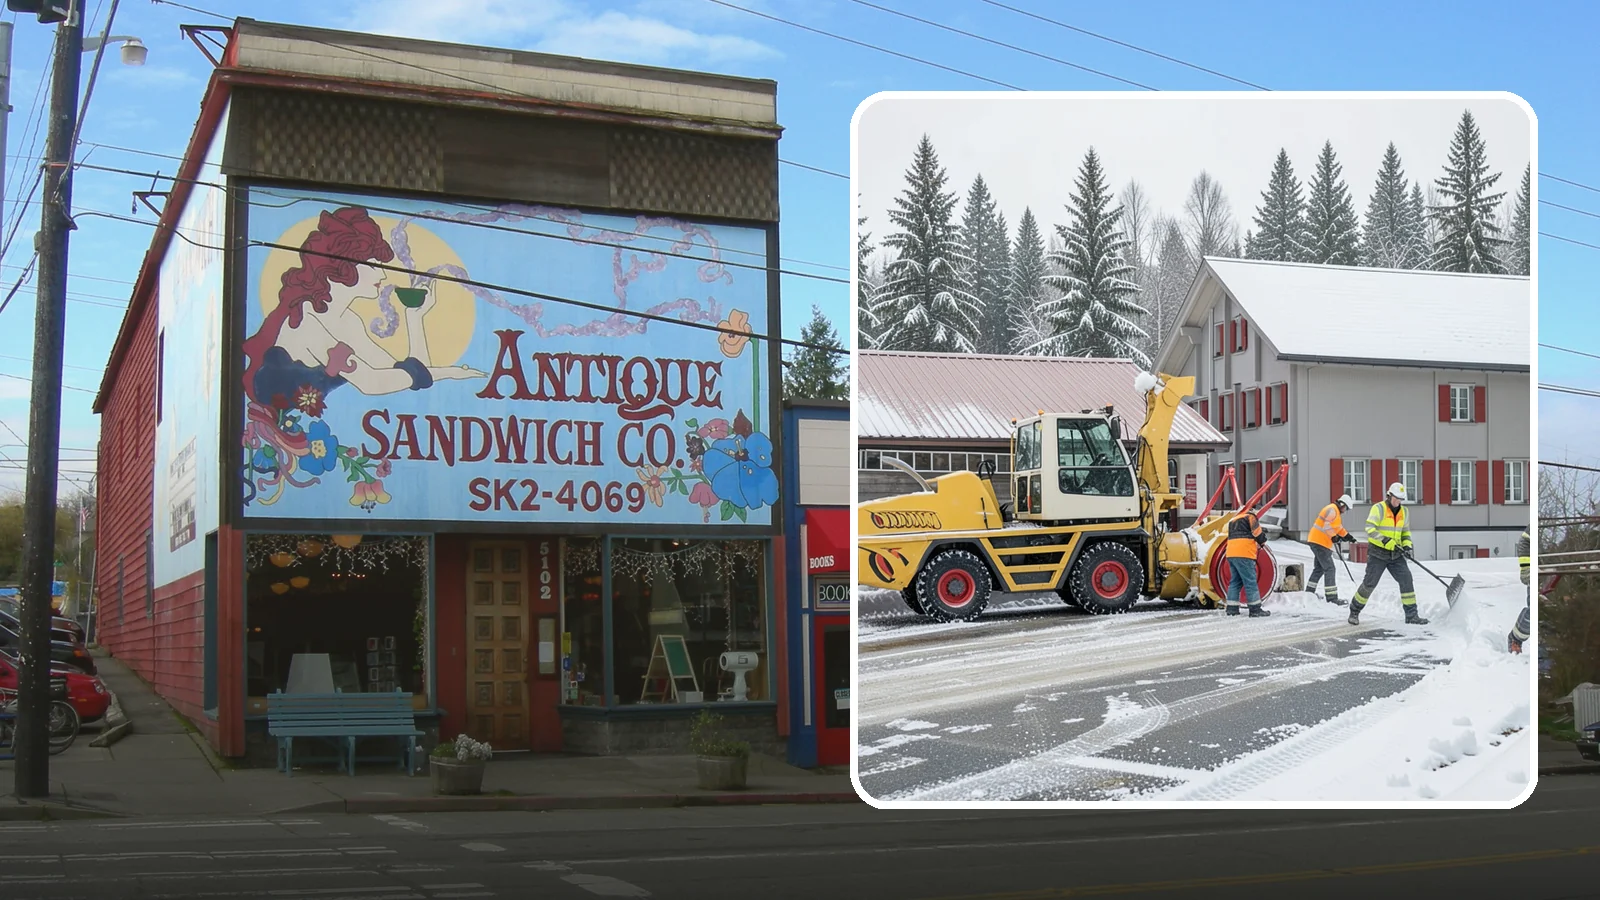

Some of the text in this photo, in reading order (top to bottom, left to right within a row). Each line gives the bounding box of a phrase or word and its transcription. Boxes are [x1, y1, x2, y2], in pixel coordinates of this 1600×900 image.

[476, 329, 723, 420] ANTIQUE
[361, 408, 684, 469] SANDWICH CO.
[468, 477, 645, 513] SK2-4069
[540, 541, 551, 600] 5102
[809, 555, 835, 569] BOOKS
